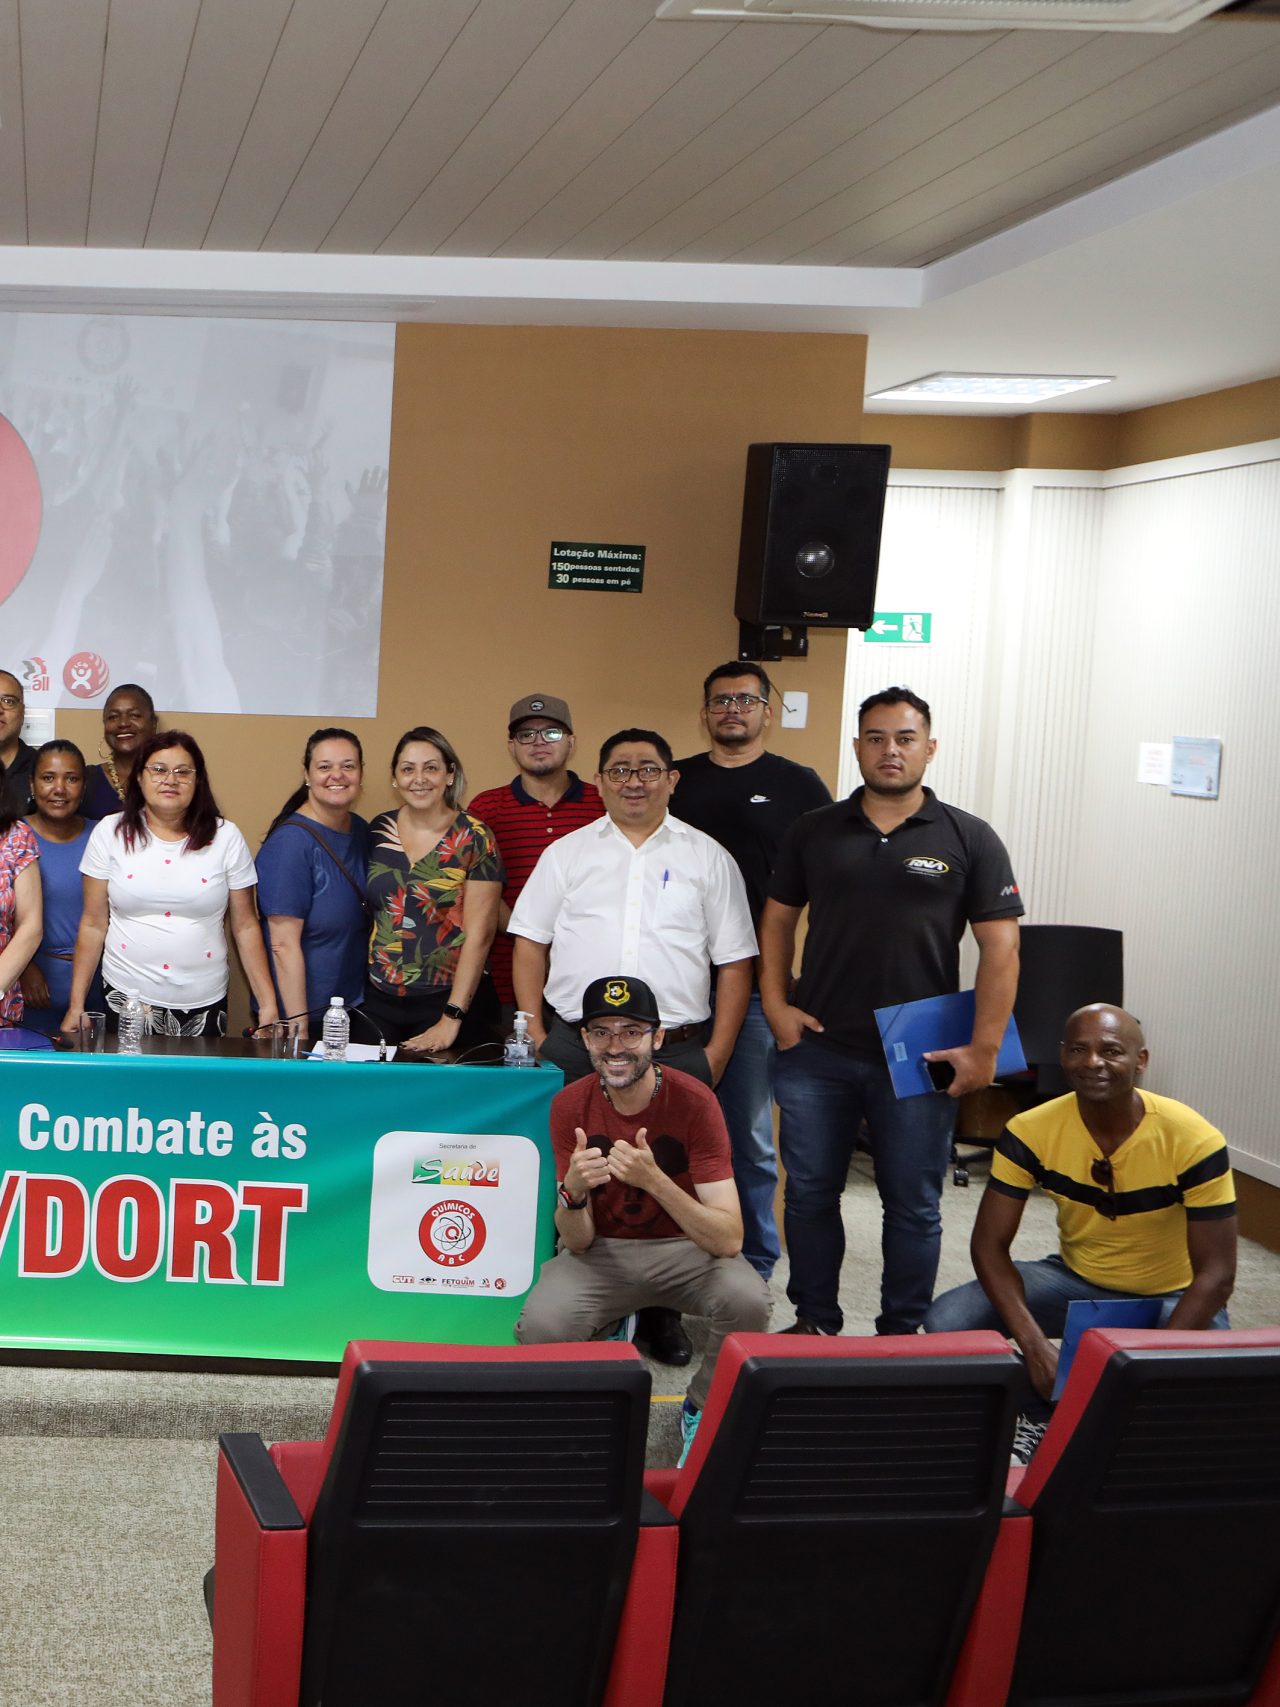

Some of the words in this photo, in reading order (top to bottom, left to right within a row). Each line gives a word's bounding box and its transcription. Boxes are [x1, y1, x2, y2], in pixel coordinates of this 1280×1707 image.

[553, 548, 594, 559] Lotação
[597, 550, 642, 560] Máxima:
[604, 564, 640, 573] sentadas
[556, 573, 570, 584] 30
[572, 576, 604, 584] pessoas
[621, 577, 631, 586] pé
[18, 1102, 234, 1157] Combate
[251, 1111, 308, 1160] às
[431, 1202, 476, 1220] QUÍMICOS
